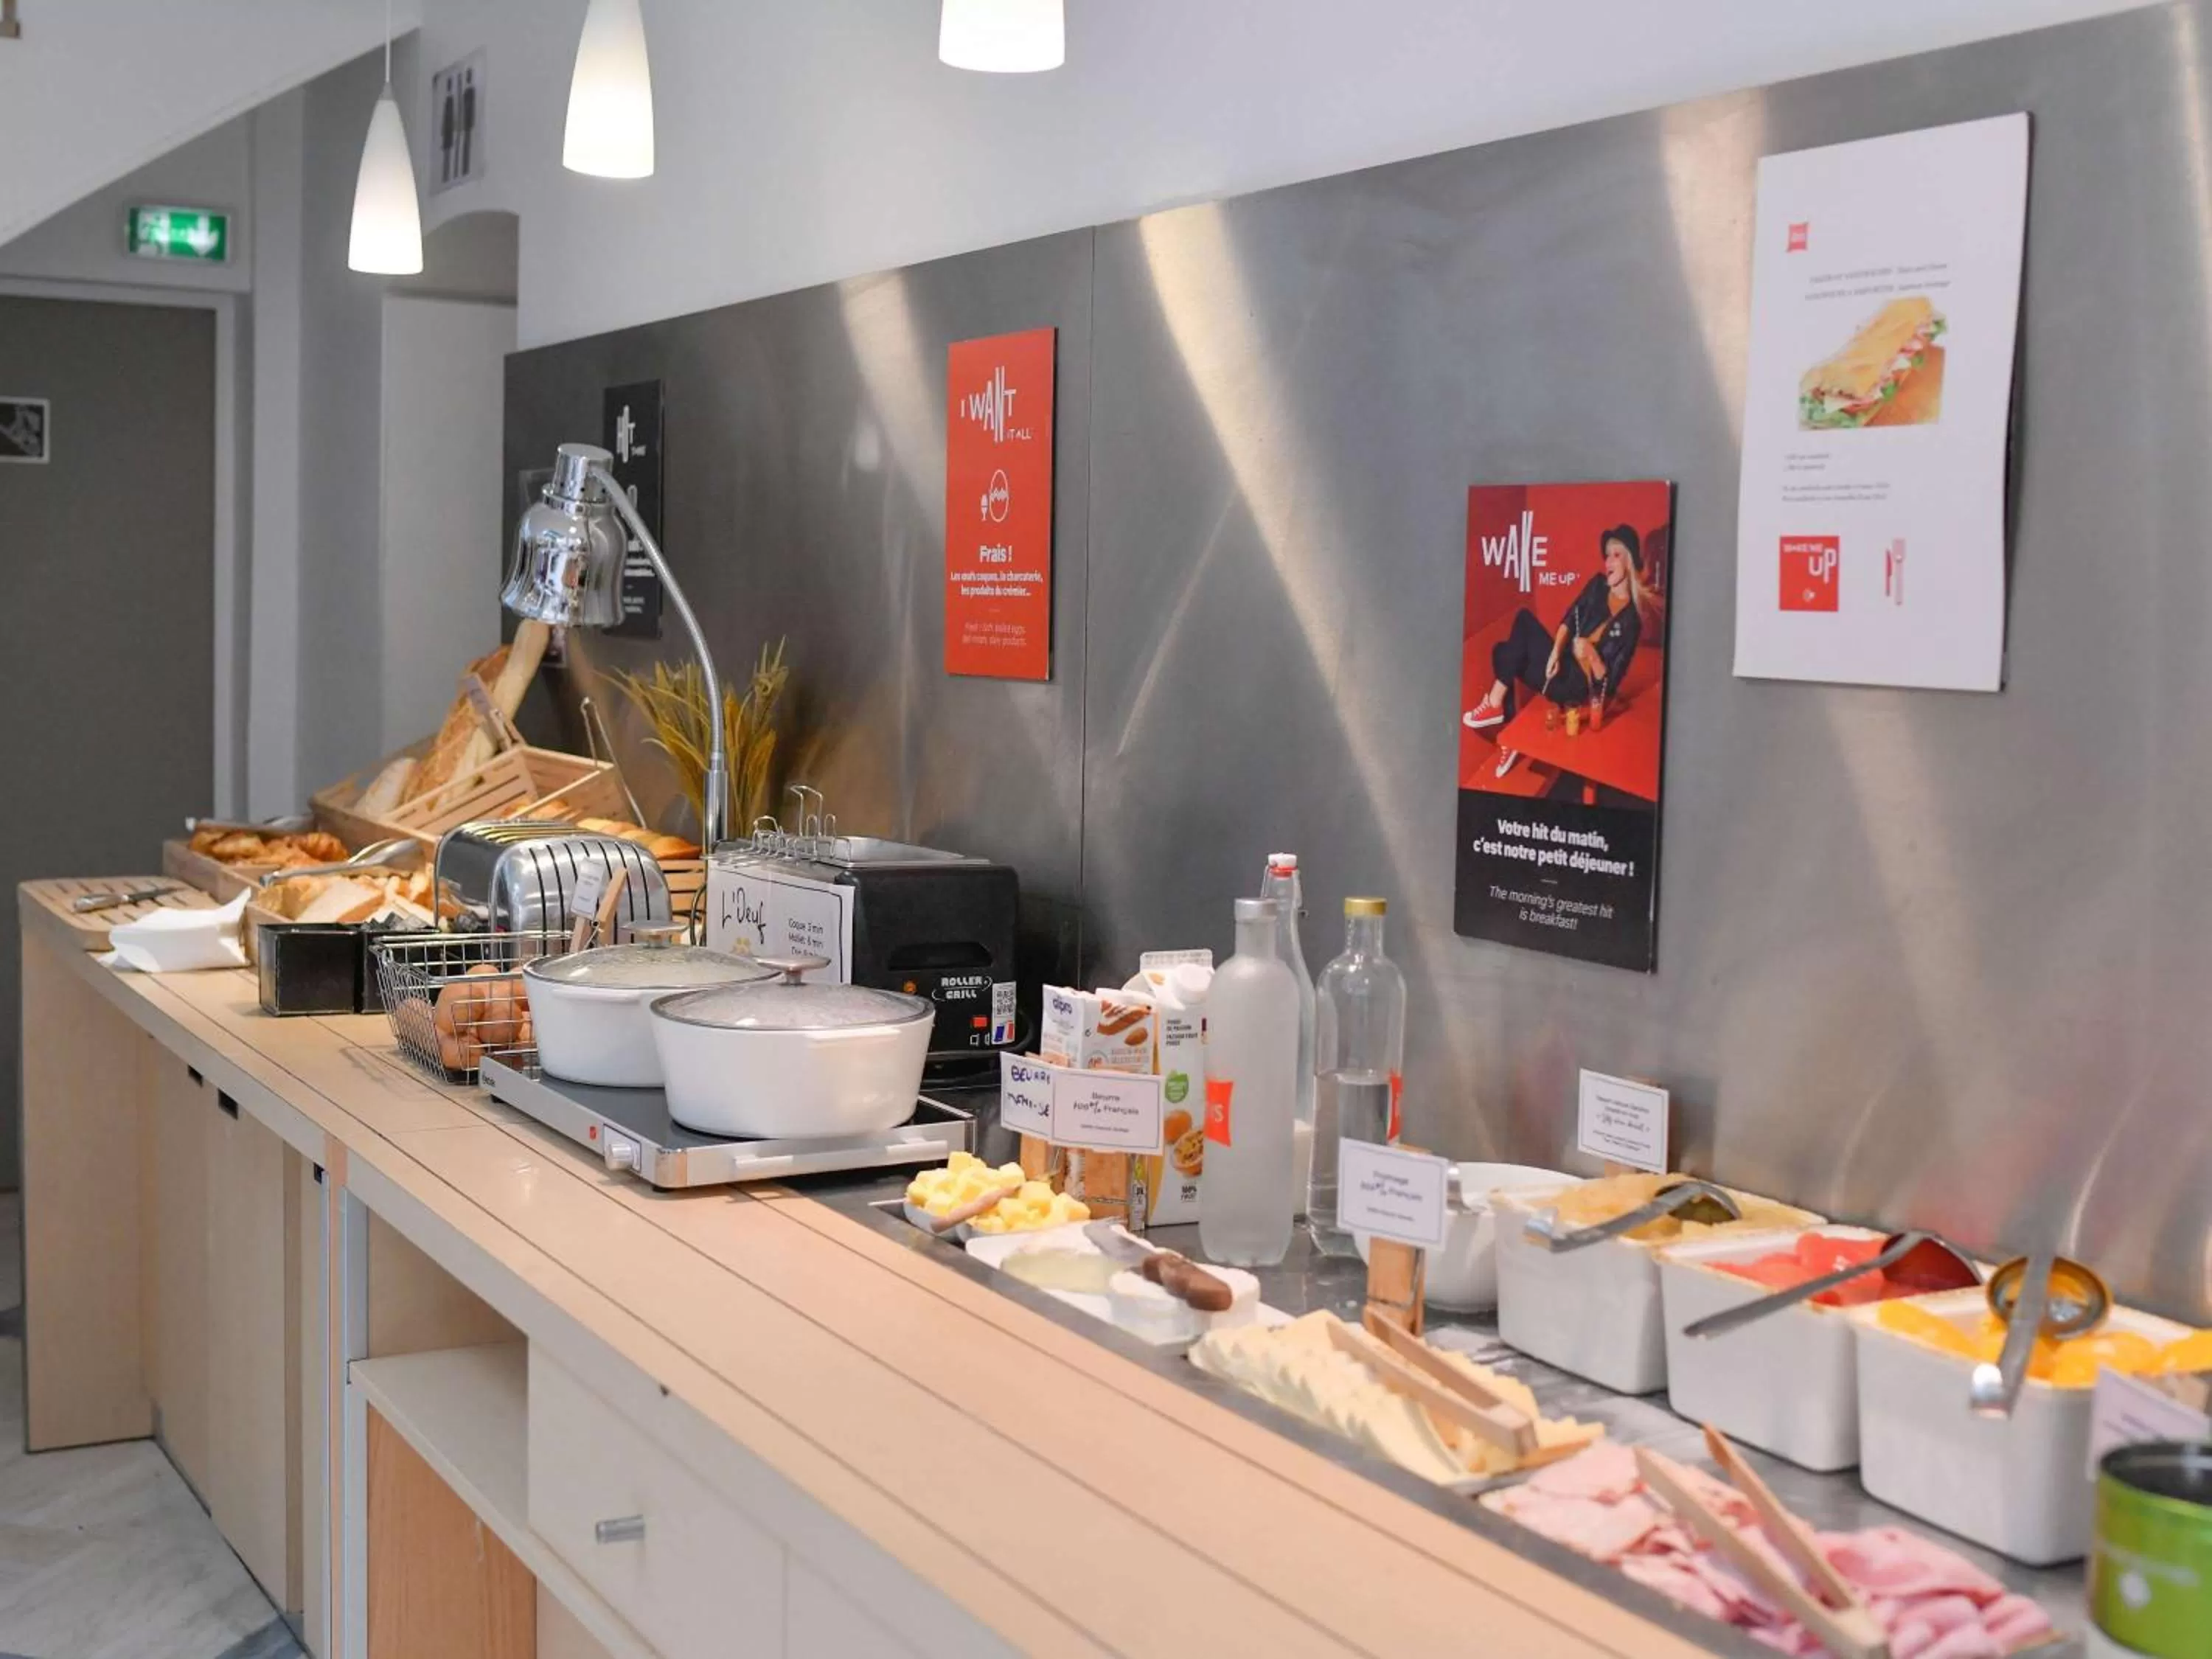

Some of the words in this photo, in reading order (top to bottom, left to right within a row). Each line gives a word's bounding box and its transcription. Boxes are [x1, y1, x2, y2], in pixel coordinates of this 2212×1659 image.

[961, 399, 965, 418] I
[969, 365, 1017, 443] WANT
[979, 544, 1007, 563] Frais
[1481, 510, 1548, 593] WAKE
[1539, 572, 1557, 585] ME
[1498, 818, 1531, 839] Votre
[1531, 821, 1549, 841] hit
[1549, 825, 1567, 844] du
[1567, 830, 1610, 852] matin,
[1472, 836, 1503, 857] c'est
[1503, 843, 1537, 862] notre
[1537, 848, 1568, 866] petit
[1568, 852, 1627, 876] déjeuner
[1489, 885, 1507, 900] The
[1508, 889, 1555, 909] morning's
[1556, 897, 1599, 917] greatest
[1599, 904, 1614, 919] hit
[1518, 906, 1528, 921] is
[940, 975, 984, 987] ROLLER
[945, 989, 977, 1000] GRILL
